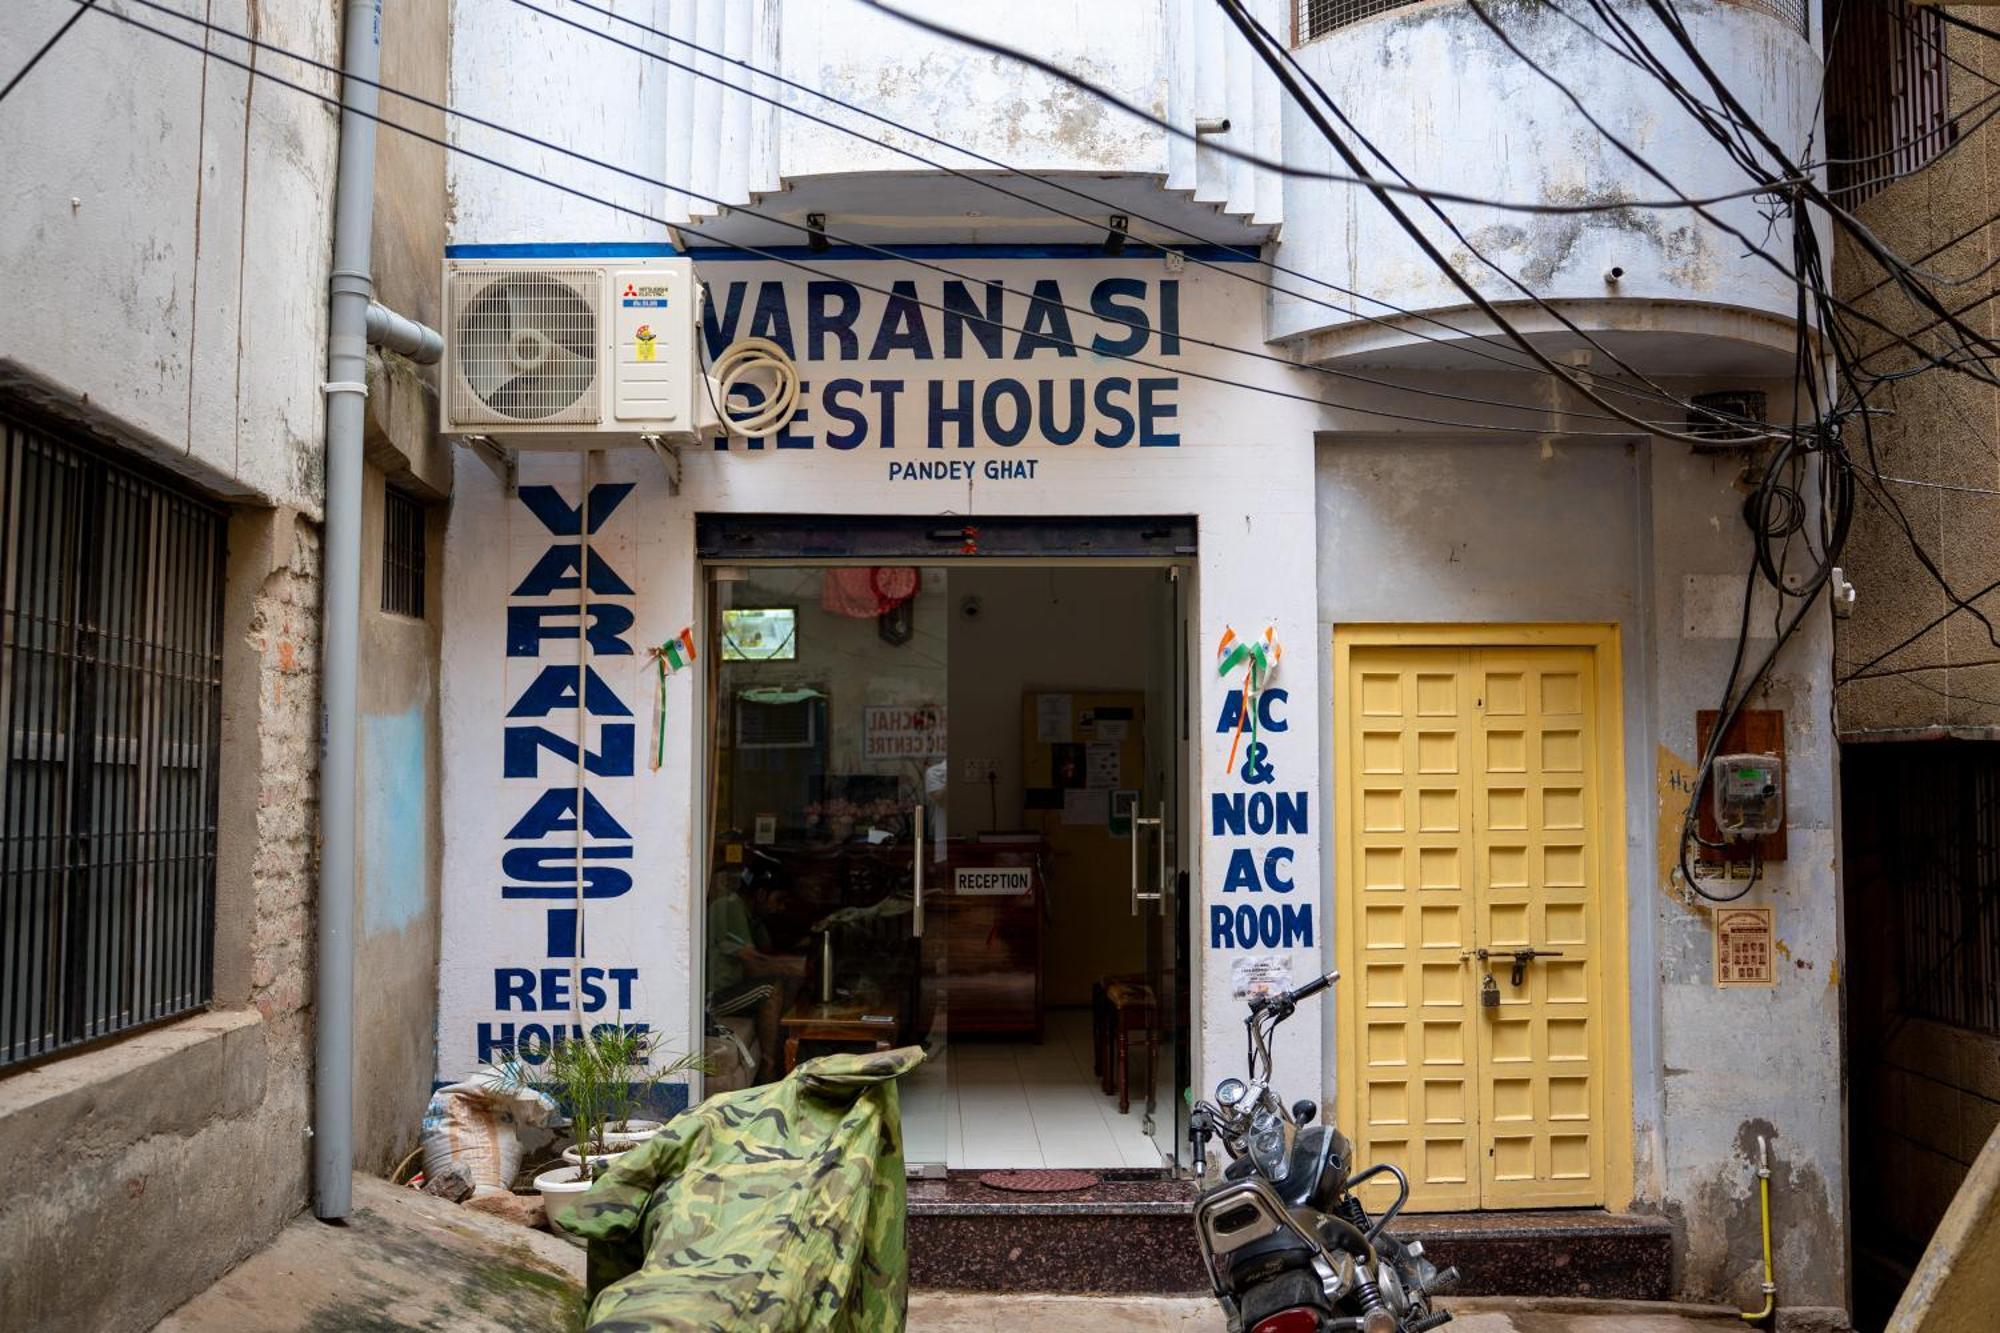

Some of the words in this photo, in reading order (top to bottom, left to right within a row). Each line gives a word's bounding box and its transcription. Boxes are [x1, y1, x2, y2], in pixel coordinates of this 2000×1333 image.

[703, 278, 1180, 361] VARANASI
[927, 376, 1180, 449] HOUSE
[888, 461, 976, 481] PANDEY
[984, 459, 1039, 480] GHAT
[501, 482, 638, 958] VARANASI
[1216, 687, 1289, 734] AC
[1241, 741, 1276, 785] &
[1211, 791, 1309, 836] NON
[959, 873, 1028, 889] RECEPTION
[1222, 846, 1296, 893] AC
[1210, 903, 1314, 949] ROOM
[494, 968, 638, 1012] REST
